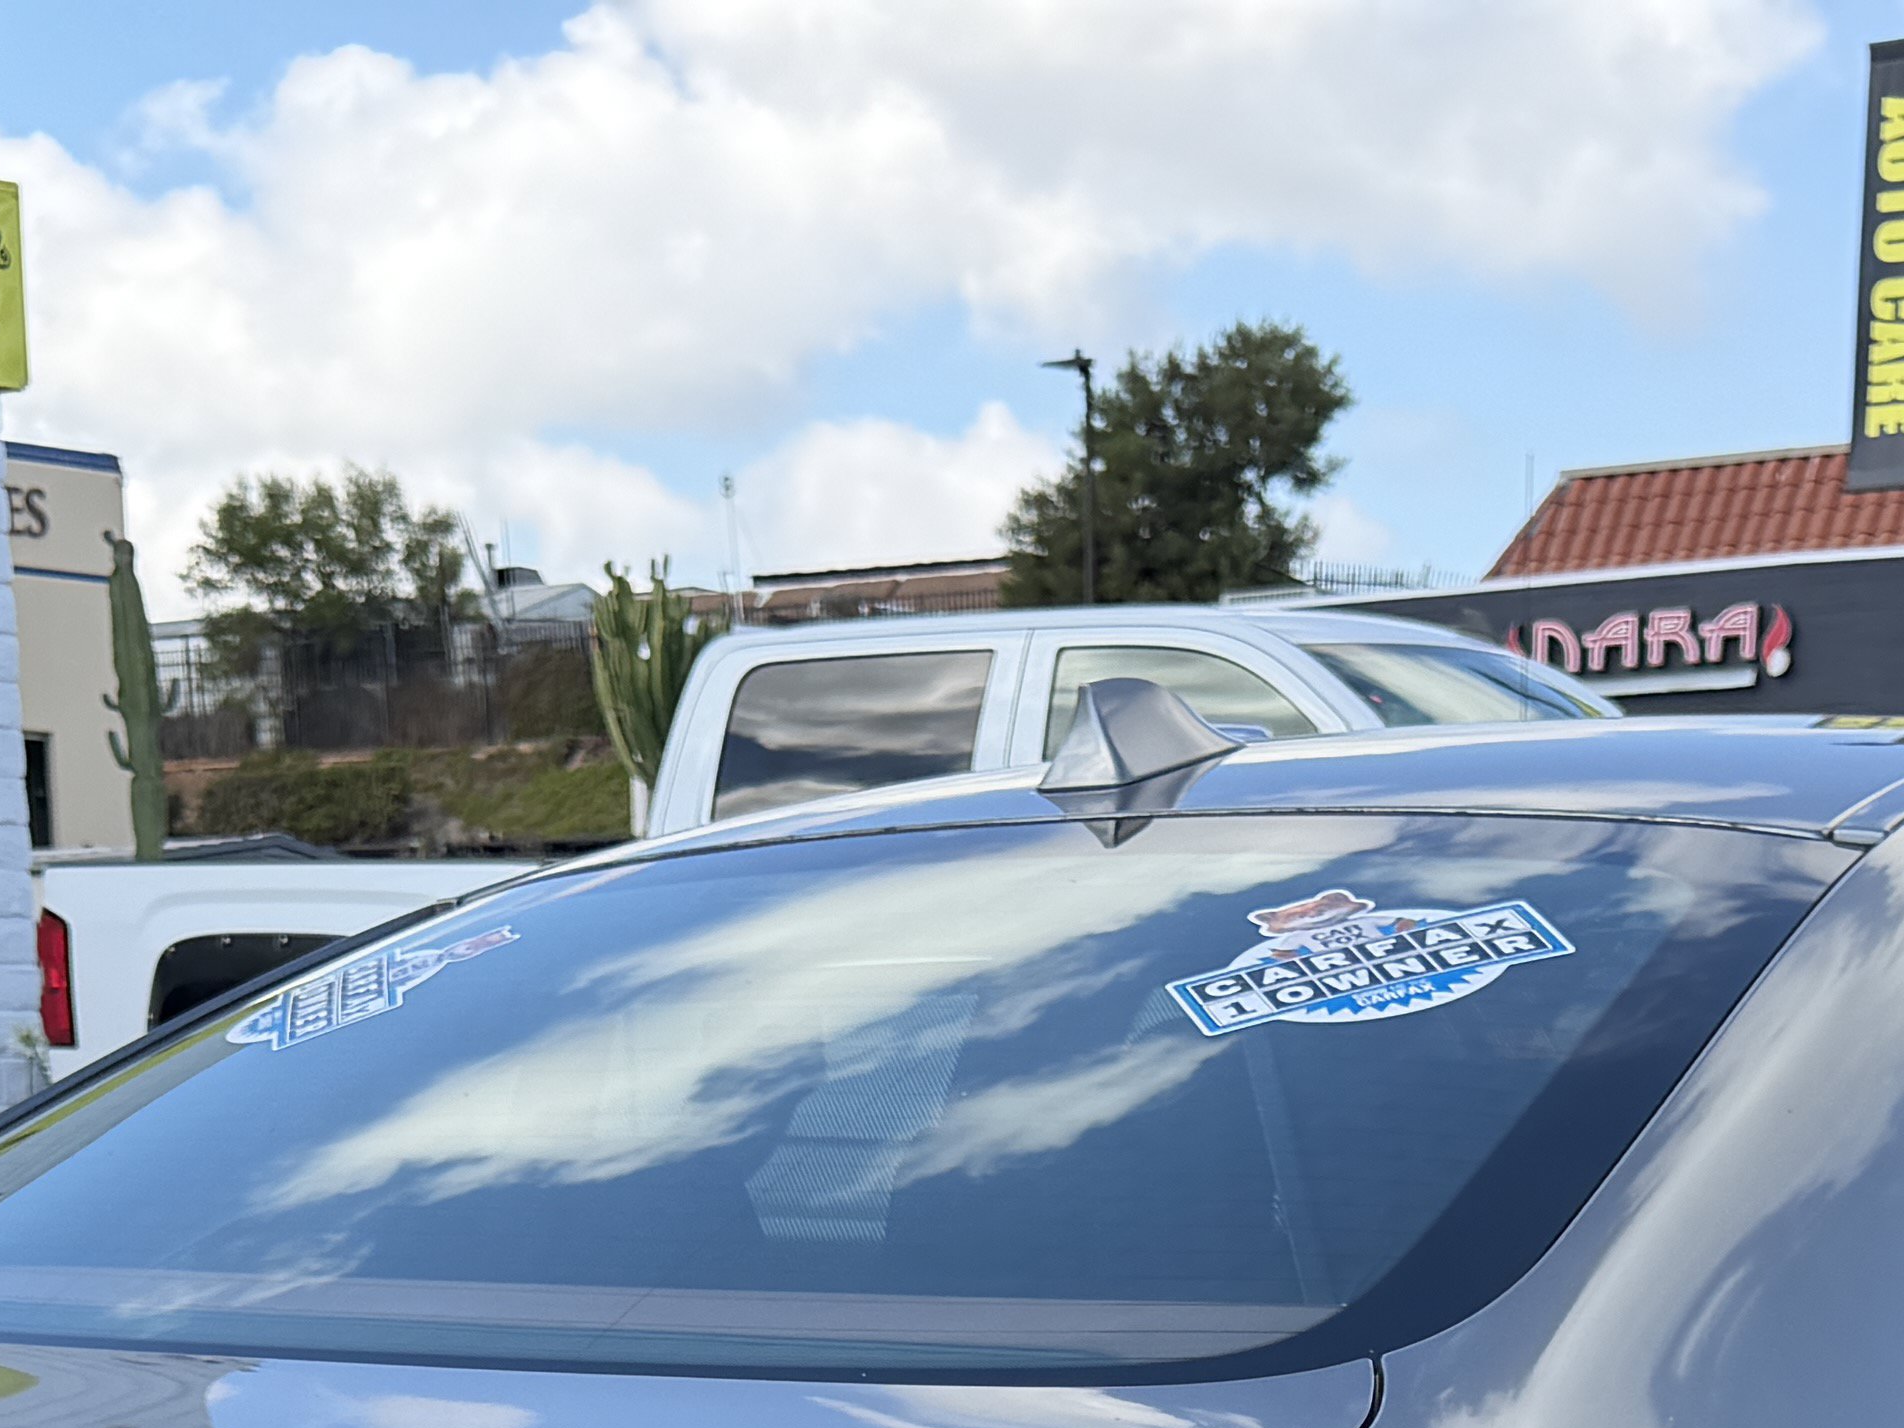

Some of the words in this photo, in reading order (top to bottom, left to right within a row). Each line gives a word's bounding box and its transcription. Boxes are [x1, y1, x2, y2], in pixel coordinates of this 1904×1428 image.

[1205, 917, 1527, 998] CARFAX
[1221, 1000, 1258, 1021] 1
[1276, 935, 1536, 1004] OWNER
